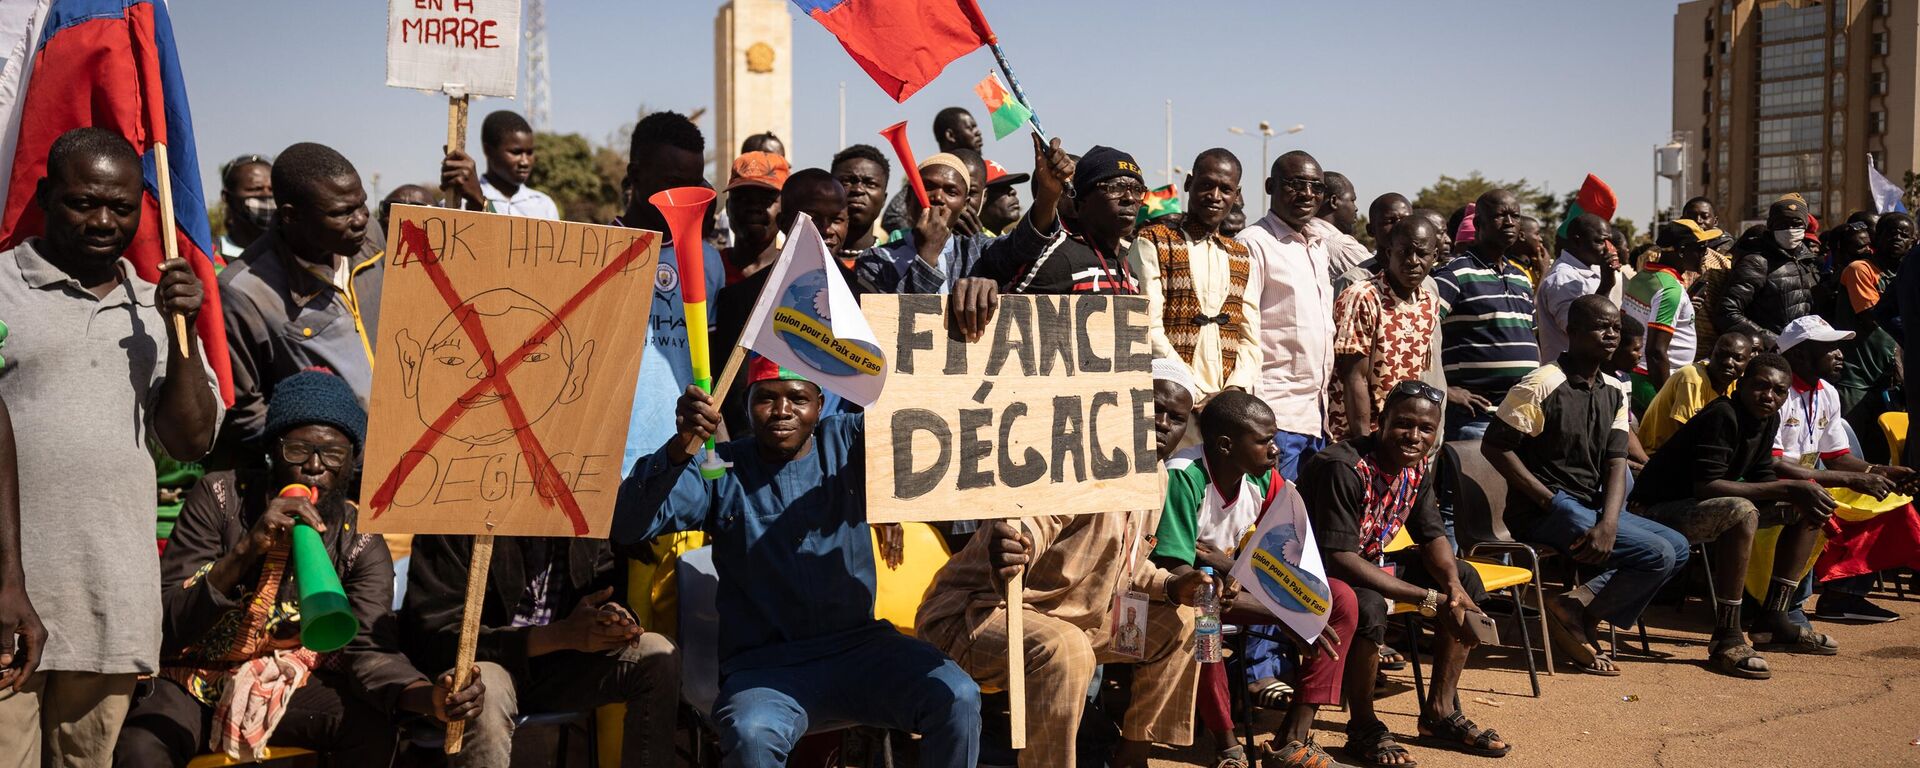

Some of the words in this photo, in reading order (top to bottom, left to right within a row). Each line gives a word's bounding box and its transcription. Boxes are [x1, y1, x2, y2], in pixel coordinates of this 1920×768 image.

[402, 17, 500, 50] MARRE
[1117, 161, 1142, 176] RE
[774, 311, 801, 329] Union
[800, 322, 822, 339] pour
[820, 333, 830, 345] la
[830, 339, 850, 357] Paix
[849, 352, 861, 364] au
[861, 357, 881, 372] Faso
[1252, 551, 1270, 567] Union
[1269, 564, 1284, 578] pour
[1283, 574, 1291, 586] la
[1289, 581, 1303, 597] Paix
[1302, 593, 1311, 603] au
[1310, 599, 1326, 613] Faso
